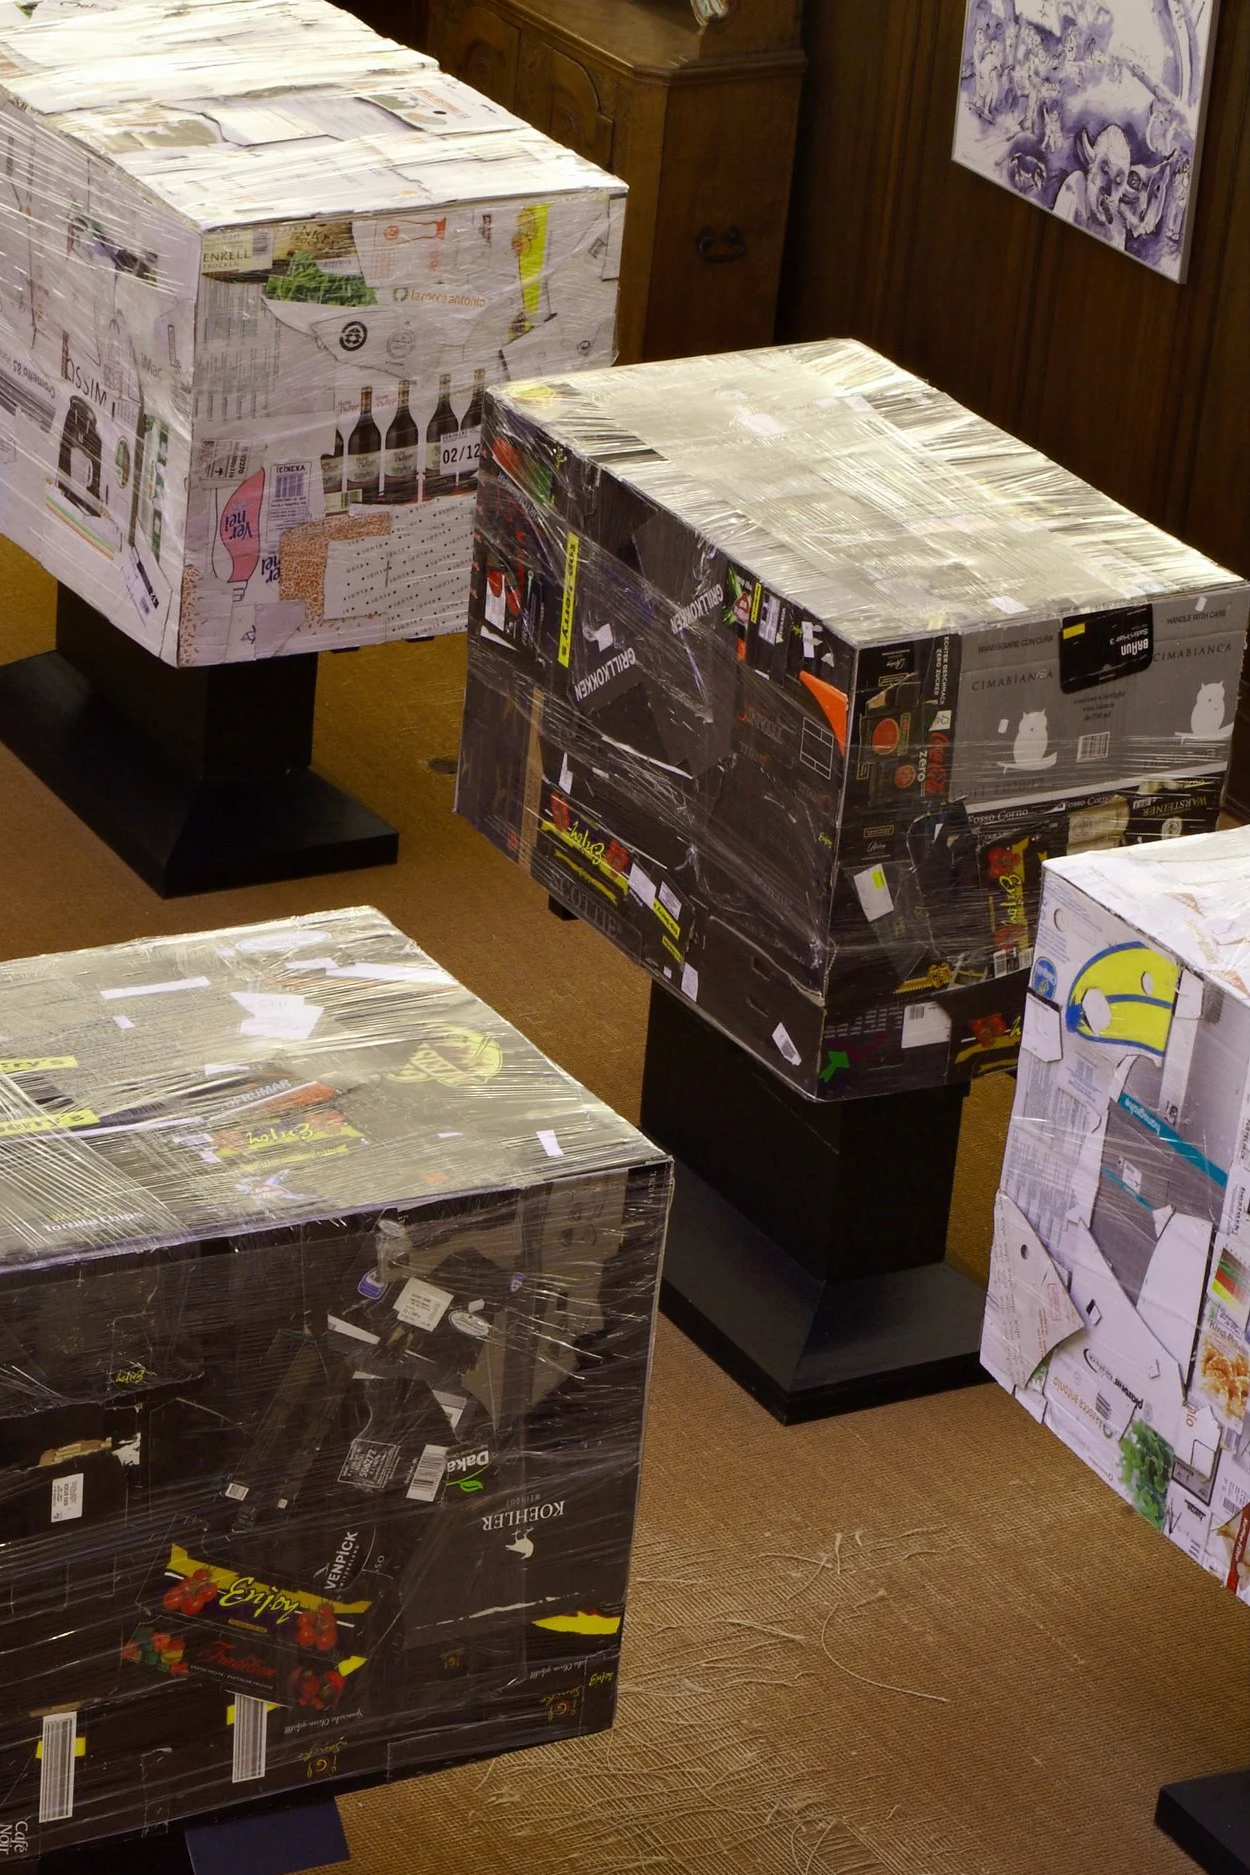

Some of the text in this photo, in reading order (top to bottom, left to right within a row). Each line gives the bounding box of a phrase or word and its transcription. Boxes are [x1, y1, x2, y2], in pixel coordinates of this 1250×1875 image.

[448, 296, 486, 308] antonio
[442, 443, 480, 464] 02/12
[670, 583, 724, 634] GRILLKOKKEN
[1167, 610, 1226, 625] HANDLE CARE
[1153, 643, 1232, 662] CIMABIANCA
[574, 648, 637, 702] GRILLKOKKEN
[971, 670, 1054, 692] CIMABIANCA
[917, 750, 927, 783] zero
[997, 808, 1029, 822] Corno
[1143, 798, 1207, 817] WARSTEINER
[1000, 873, 1022, 928] Enjoy
[481, 1499, 566, 1534] KOEHLER
[219, 1576, 300, 1625] Enjoy
[12, 1820, 29, 1854] Café
